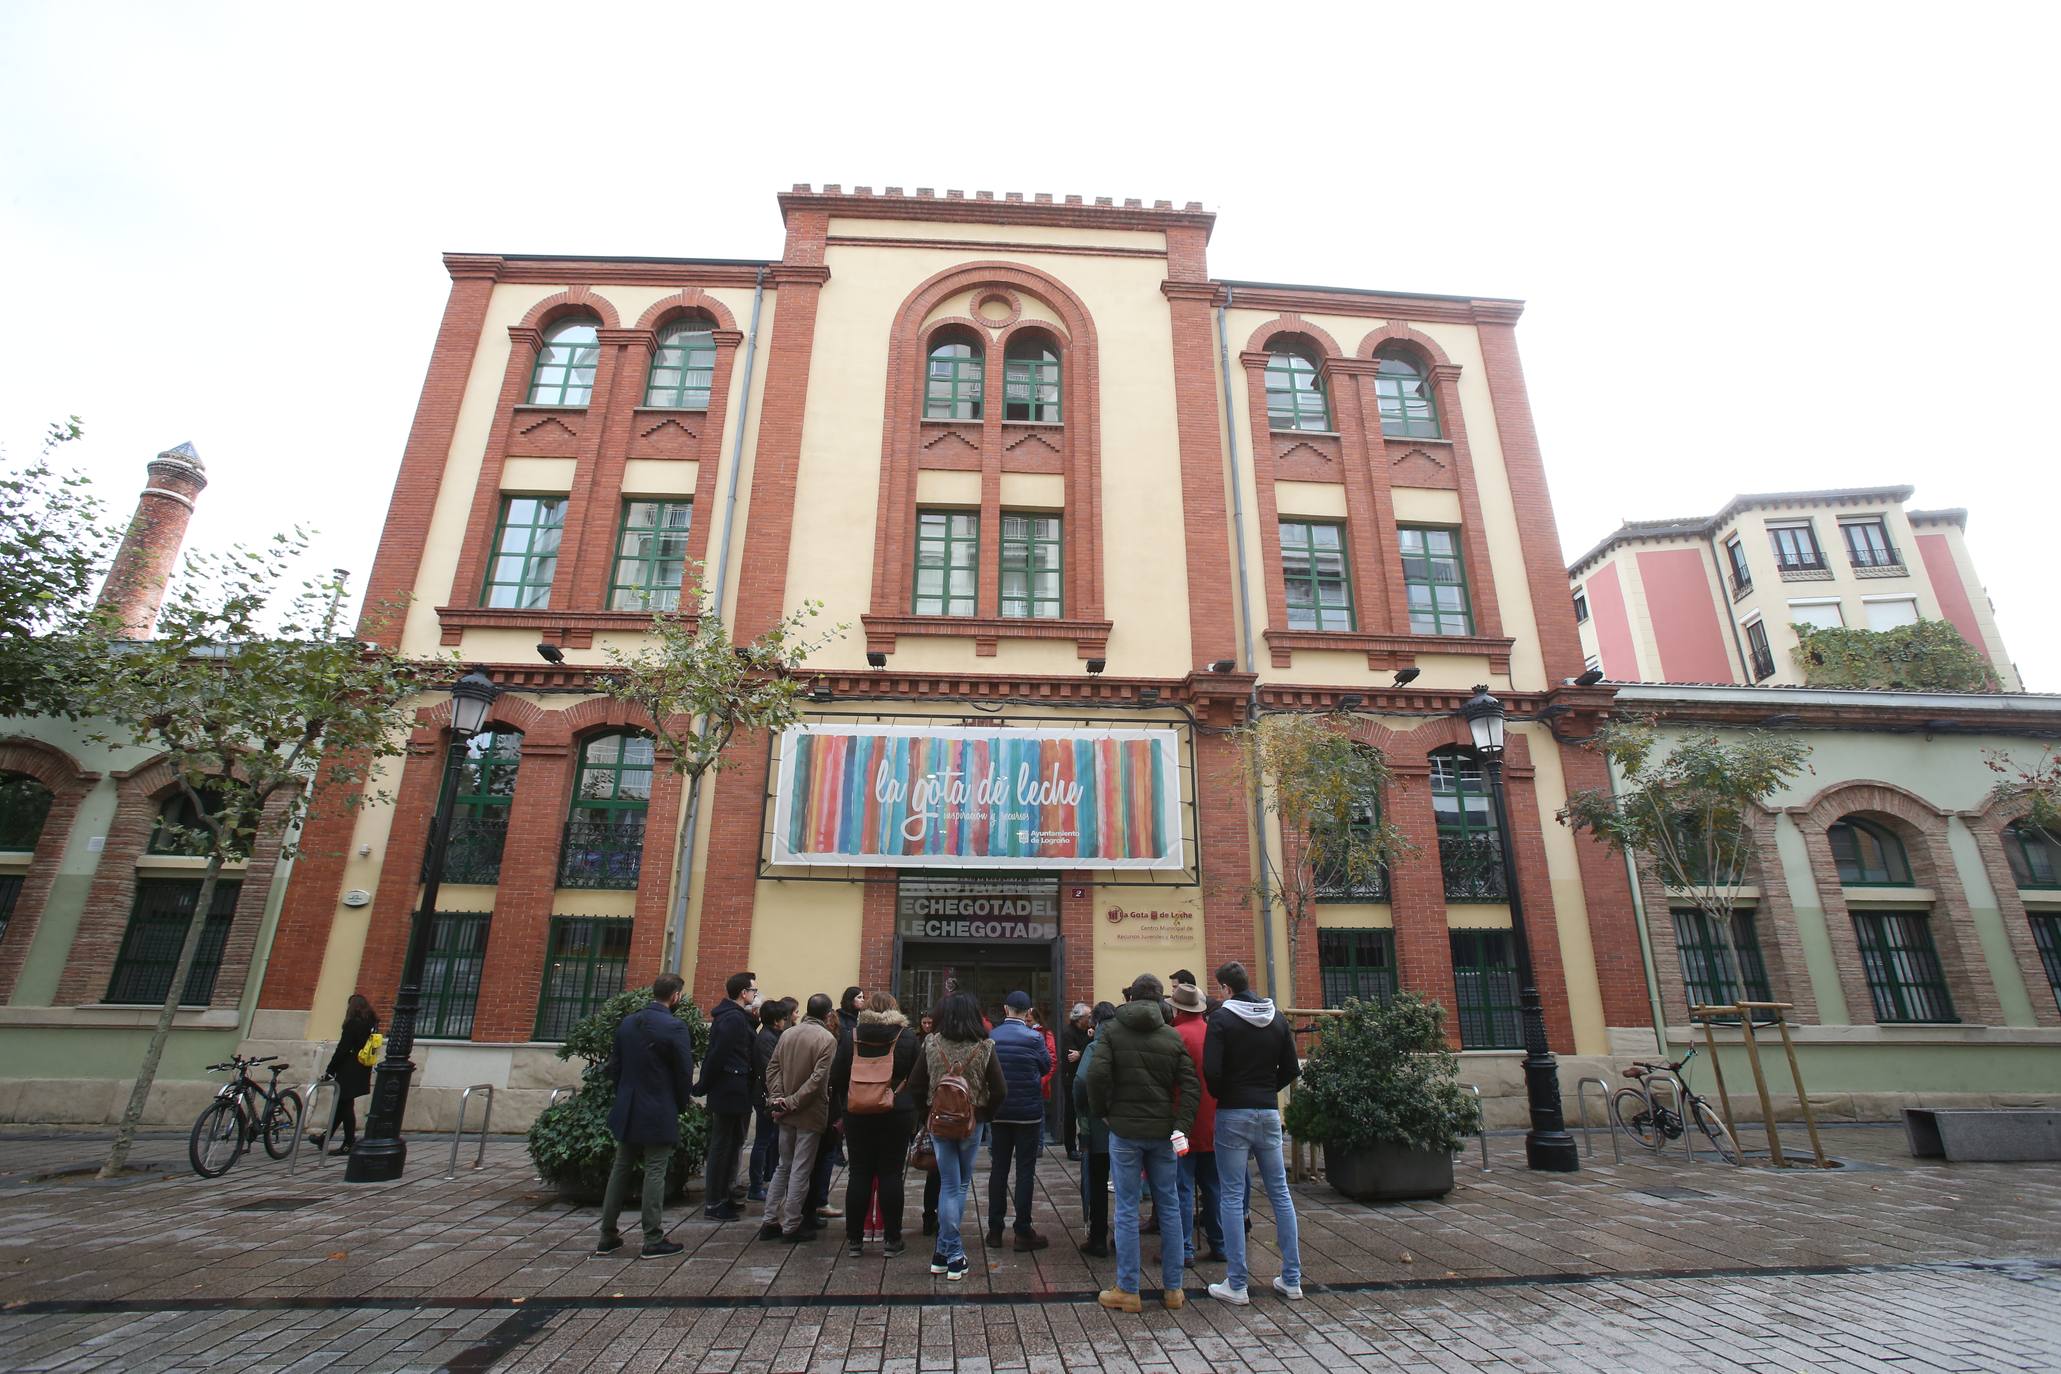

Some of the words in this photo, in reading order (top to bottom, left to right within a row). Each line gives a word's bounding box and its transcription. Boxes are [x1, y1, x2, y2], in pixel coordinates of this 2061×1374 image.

[875, 759, 907, 804] la
[900, 765, 971, 841] gota
[978, 761, 1010, 806] de
[1017, 761, 1084, 806] leche
[1030, 830, 1080, 839] Ayuntamiento
[1041, 837, 1070, 846] Logroño
[901, 898, 1058, 916] ECHEGOTADEL
[1130, 911, 1149, 919] Gota
[1159, 911, 1169, 919] de
[1171, 911, 1193, 919] Leche
